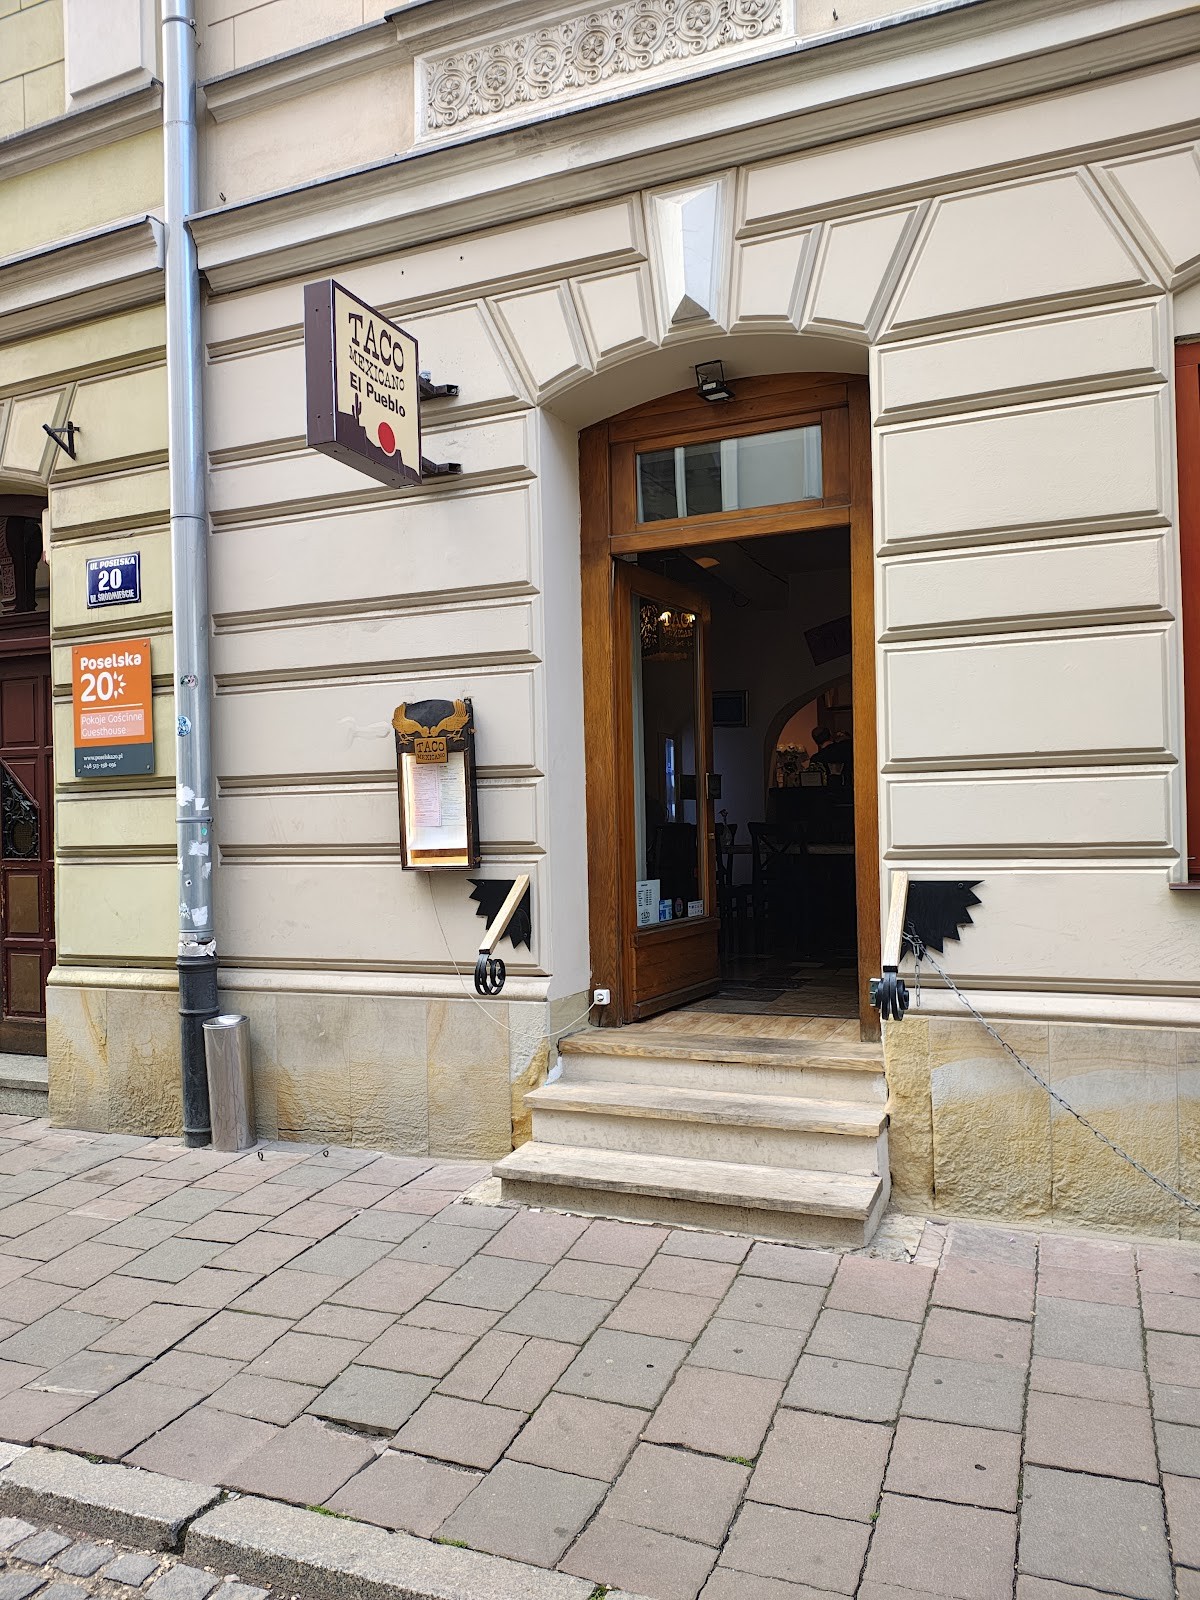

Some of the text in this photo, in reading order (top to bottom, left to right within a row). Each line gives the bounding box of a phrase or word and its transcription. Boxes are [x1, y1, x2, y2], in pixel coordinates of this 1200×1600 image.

[349, 312, 404, 372] TACO
[349, 344, 405, 391] MEXICANO
[349, 371, 406, 418] El Pueblo
[100, 557, 135, 569] POSELSKA
[98, 568, 122, 591] 20
[81, 652, 141, 670] Poselska
[81, 672, 113, 702] 20
[81, 713, 143, 725] Pokoje Gościnne
[82, 727, 127, 737] Guesthouse
[417, 741, 444, 752] TACO
